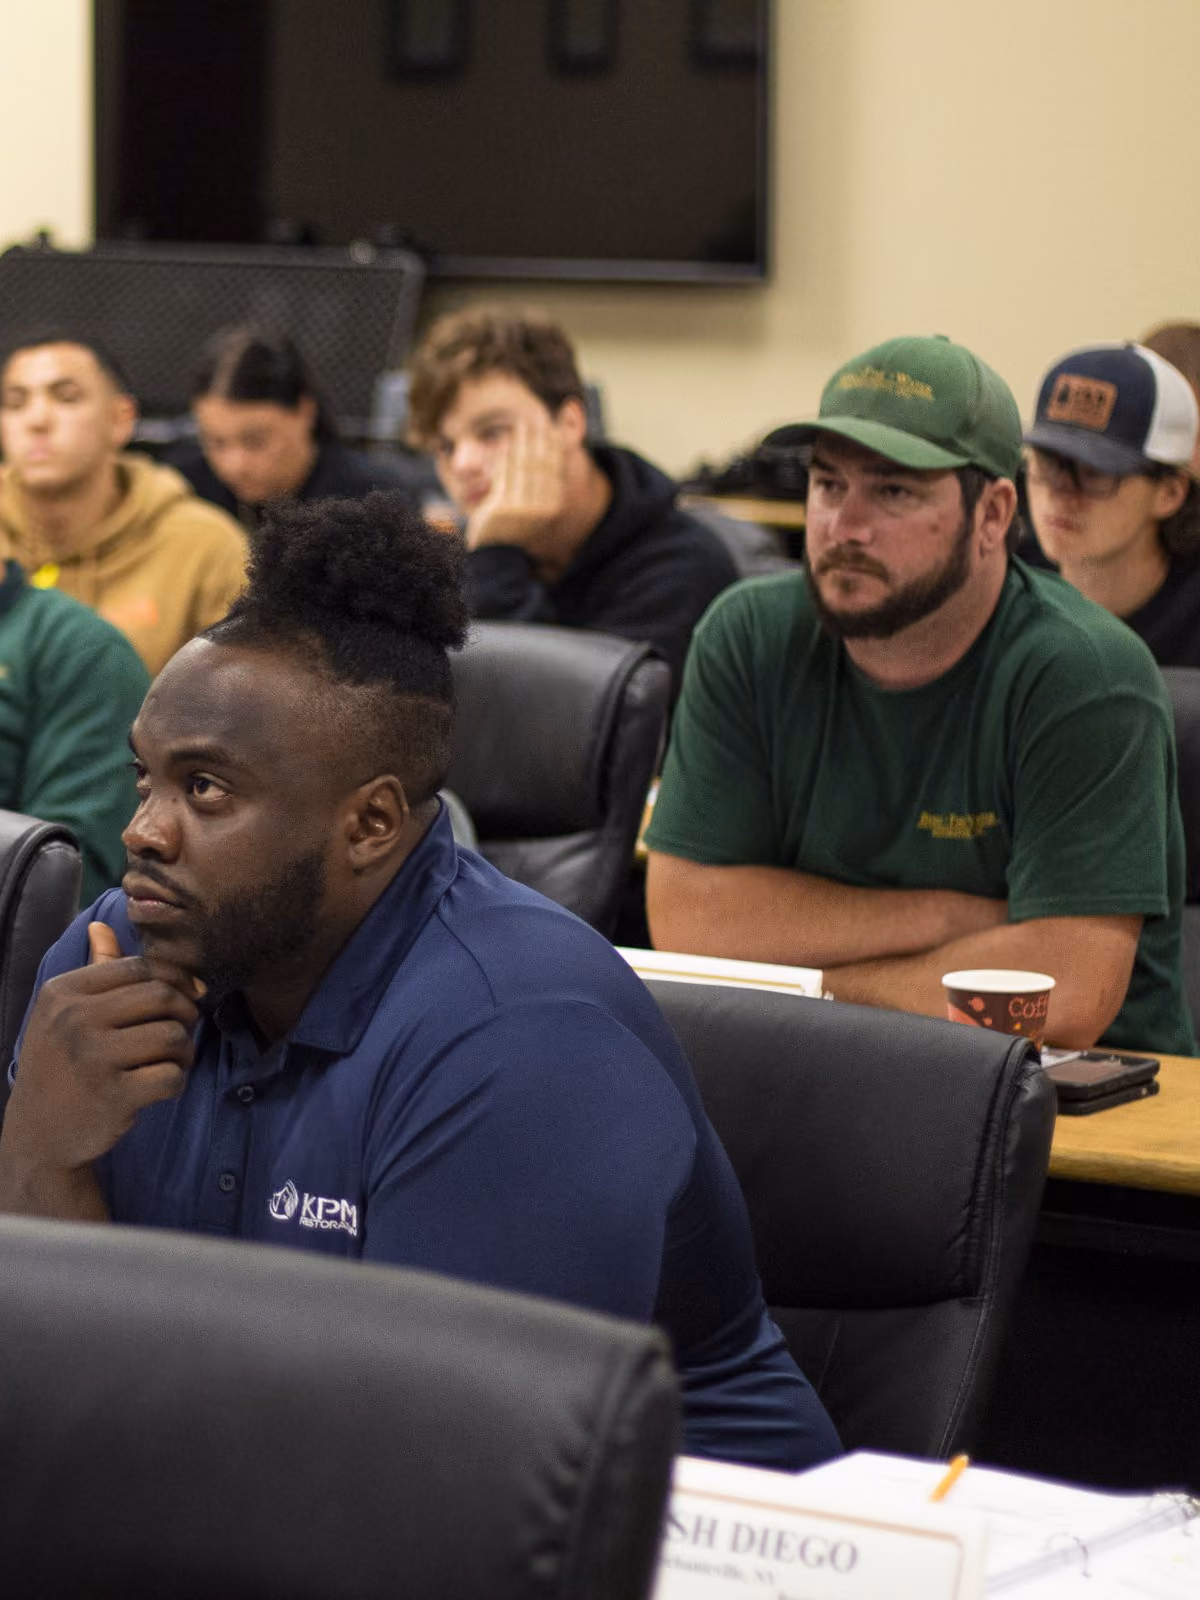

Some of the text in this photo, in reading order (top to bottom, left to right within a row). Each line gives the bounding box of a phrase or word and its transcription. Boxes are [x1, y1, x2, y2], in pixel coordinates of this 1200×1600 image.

[302, 1192, 357, 1228] KPM
[664, 1510, 860, 1575] SH DIEGO
